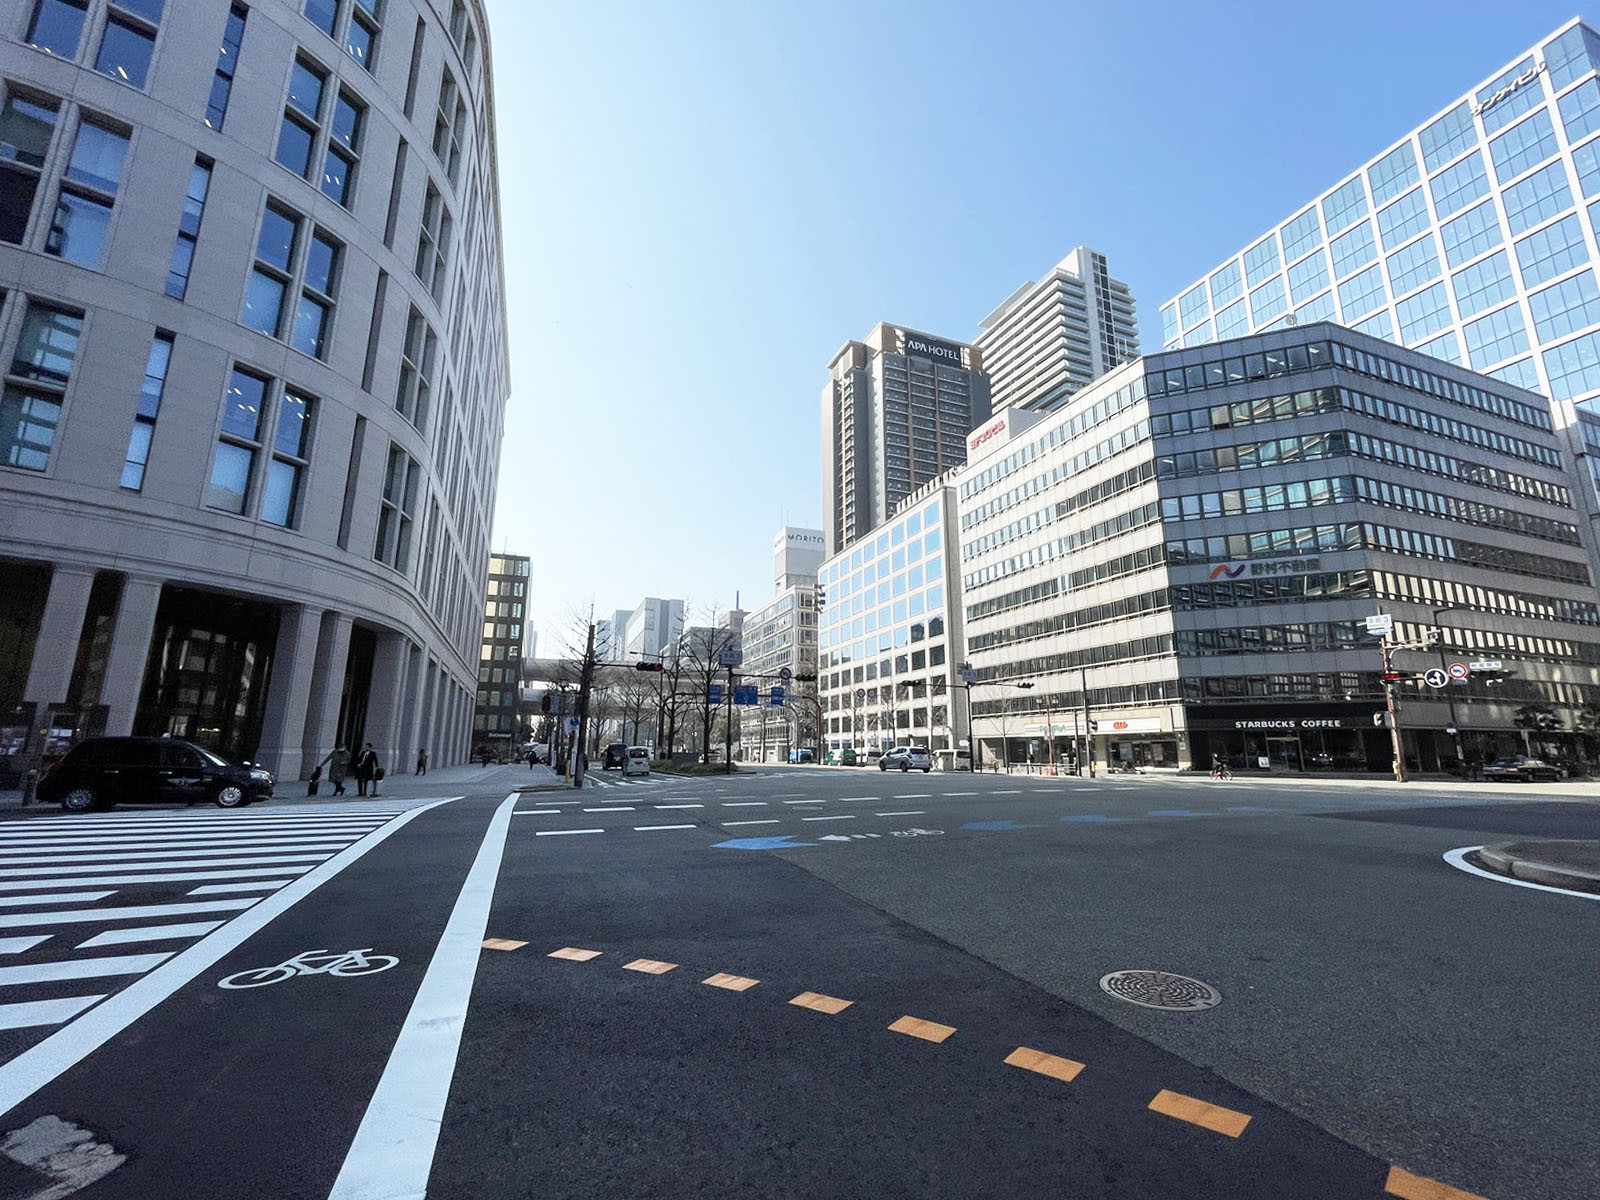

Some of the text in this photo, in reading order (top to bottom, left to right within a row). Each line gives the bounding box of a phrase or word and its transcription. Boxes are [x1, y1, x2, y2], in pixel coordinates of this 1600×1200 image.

[908, 340, 959, 361] APA HOTEL
[788, 534, 825, 544] MORITO
[1113, 721, 1128, 729] au
[1235, 719, 1341, 728] STARBUCKS COFFEE
